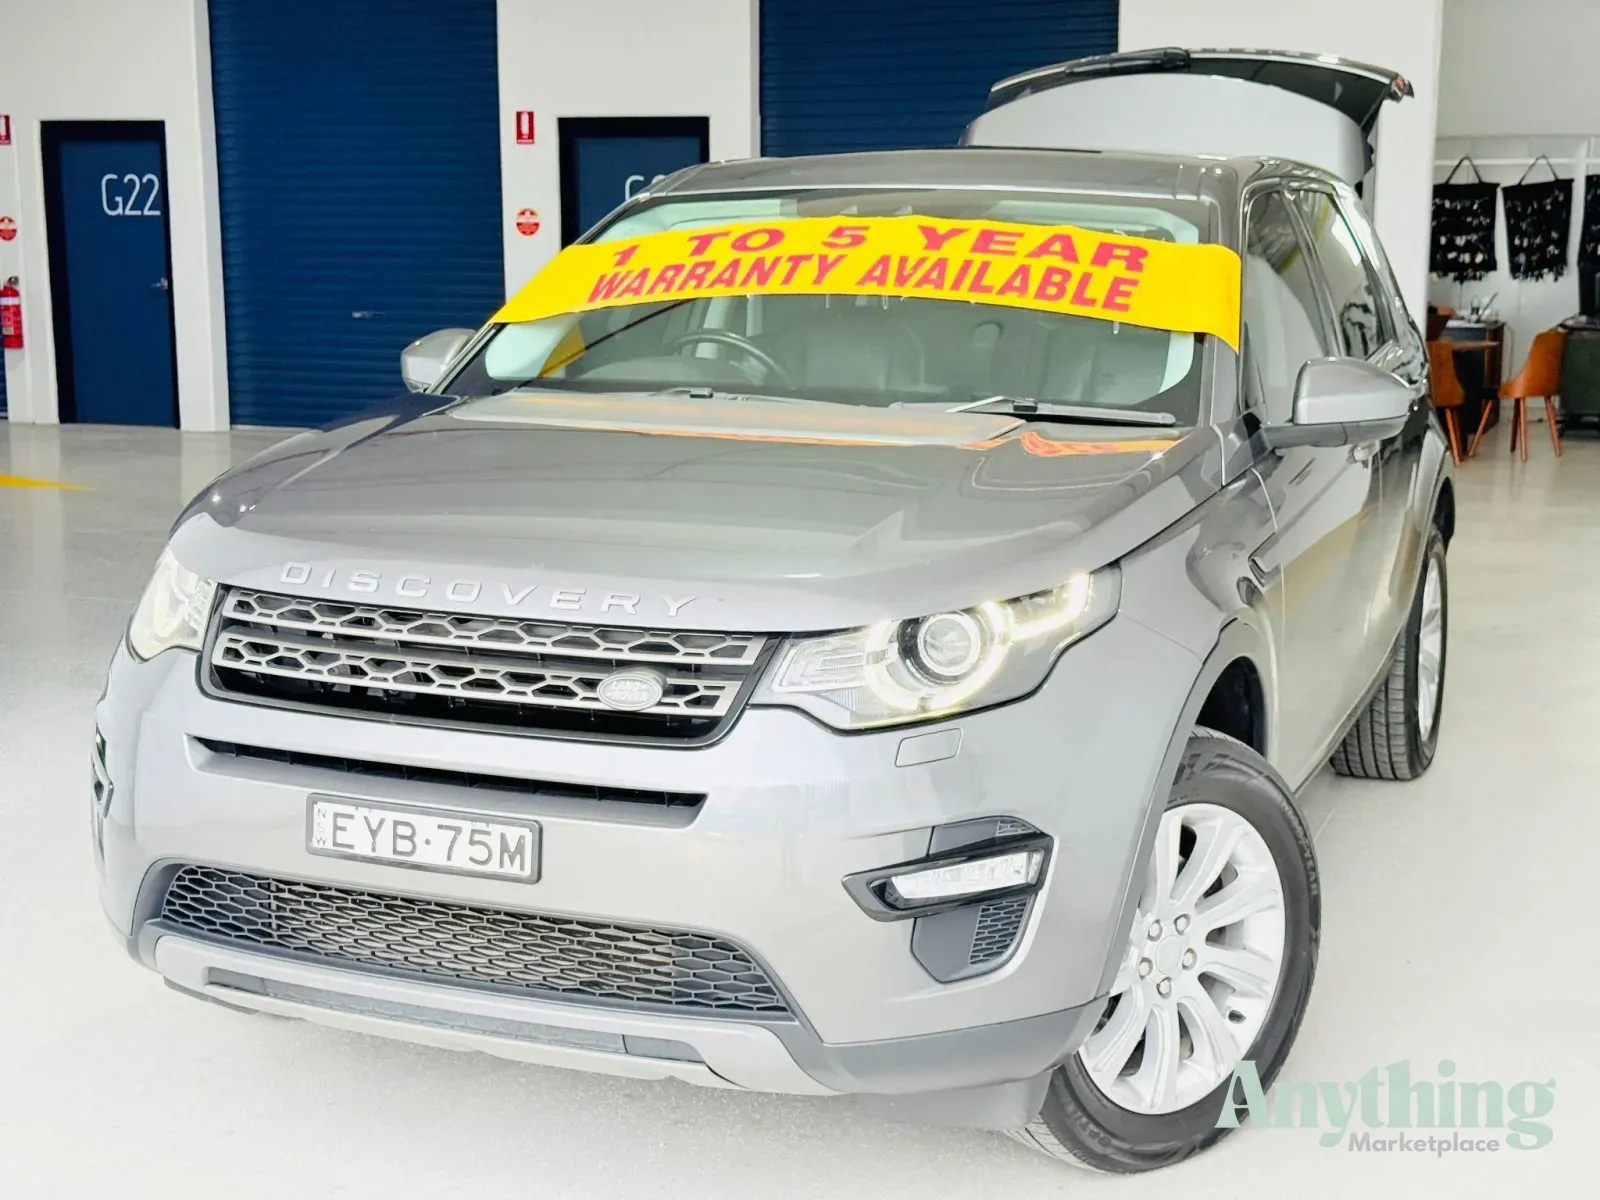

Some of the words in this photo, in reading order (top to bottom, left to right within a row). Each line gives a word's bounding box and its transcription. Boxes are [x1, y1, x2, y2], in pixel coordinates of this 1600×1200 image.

[101, 173, 161, 216] G22
[614, 244, 640, 267] 1
[688, 228, 785, 257] TO
[821, 225, 869, 249] 5
[917, 225, 1149, 273] YEAR
[587, 254, 846, 303] WARRANTY
[856, 254, 1140, 312] AVAILABLE
[280, 562, 699, 617] DISCOVERY
